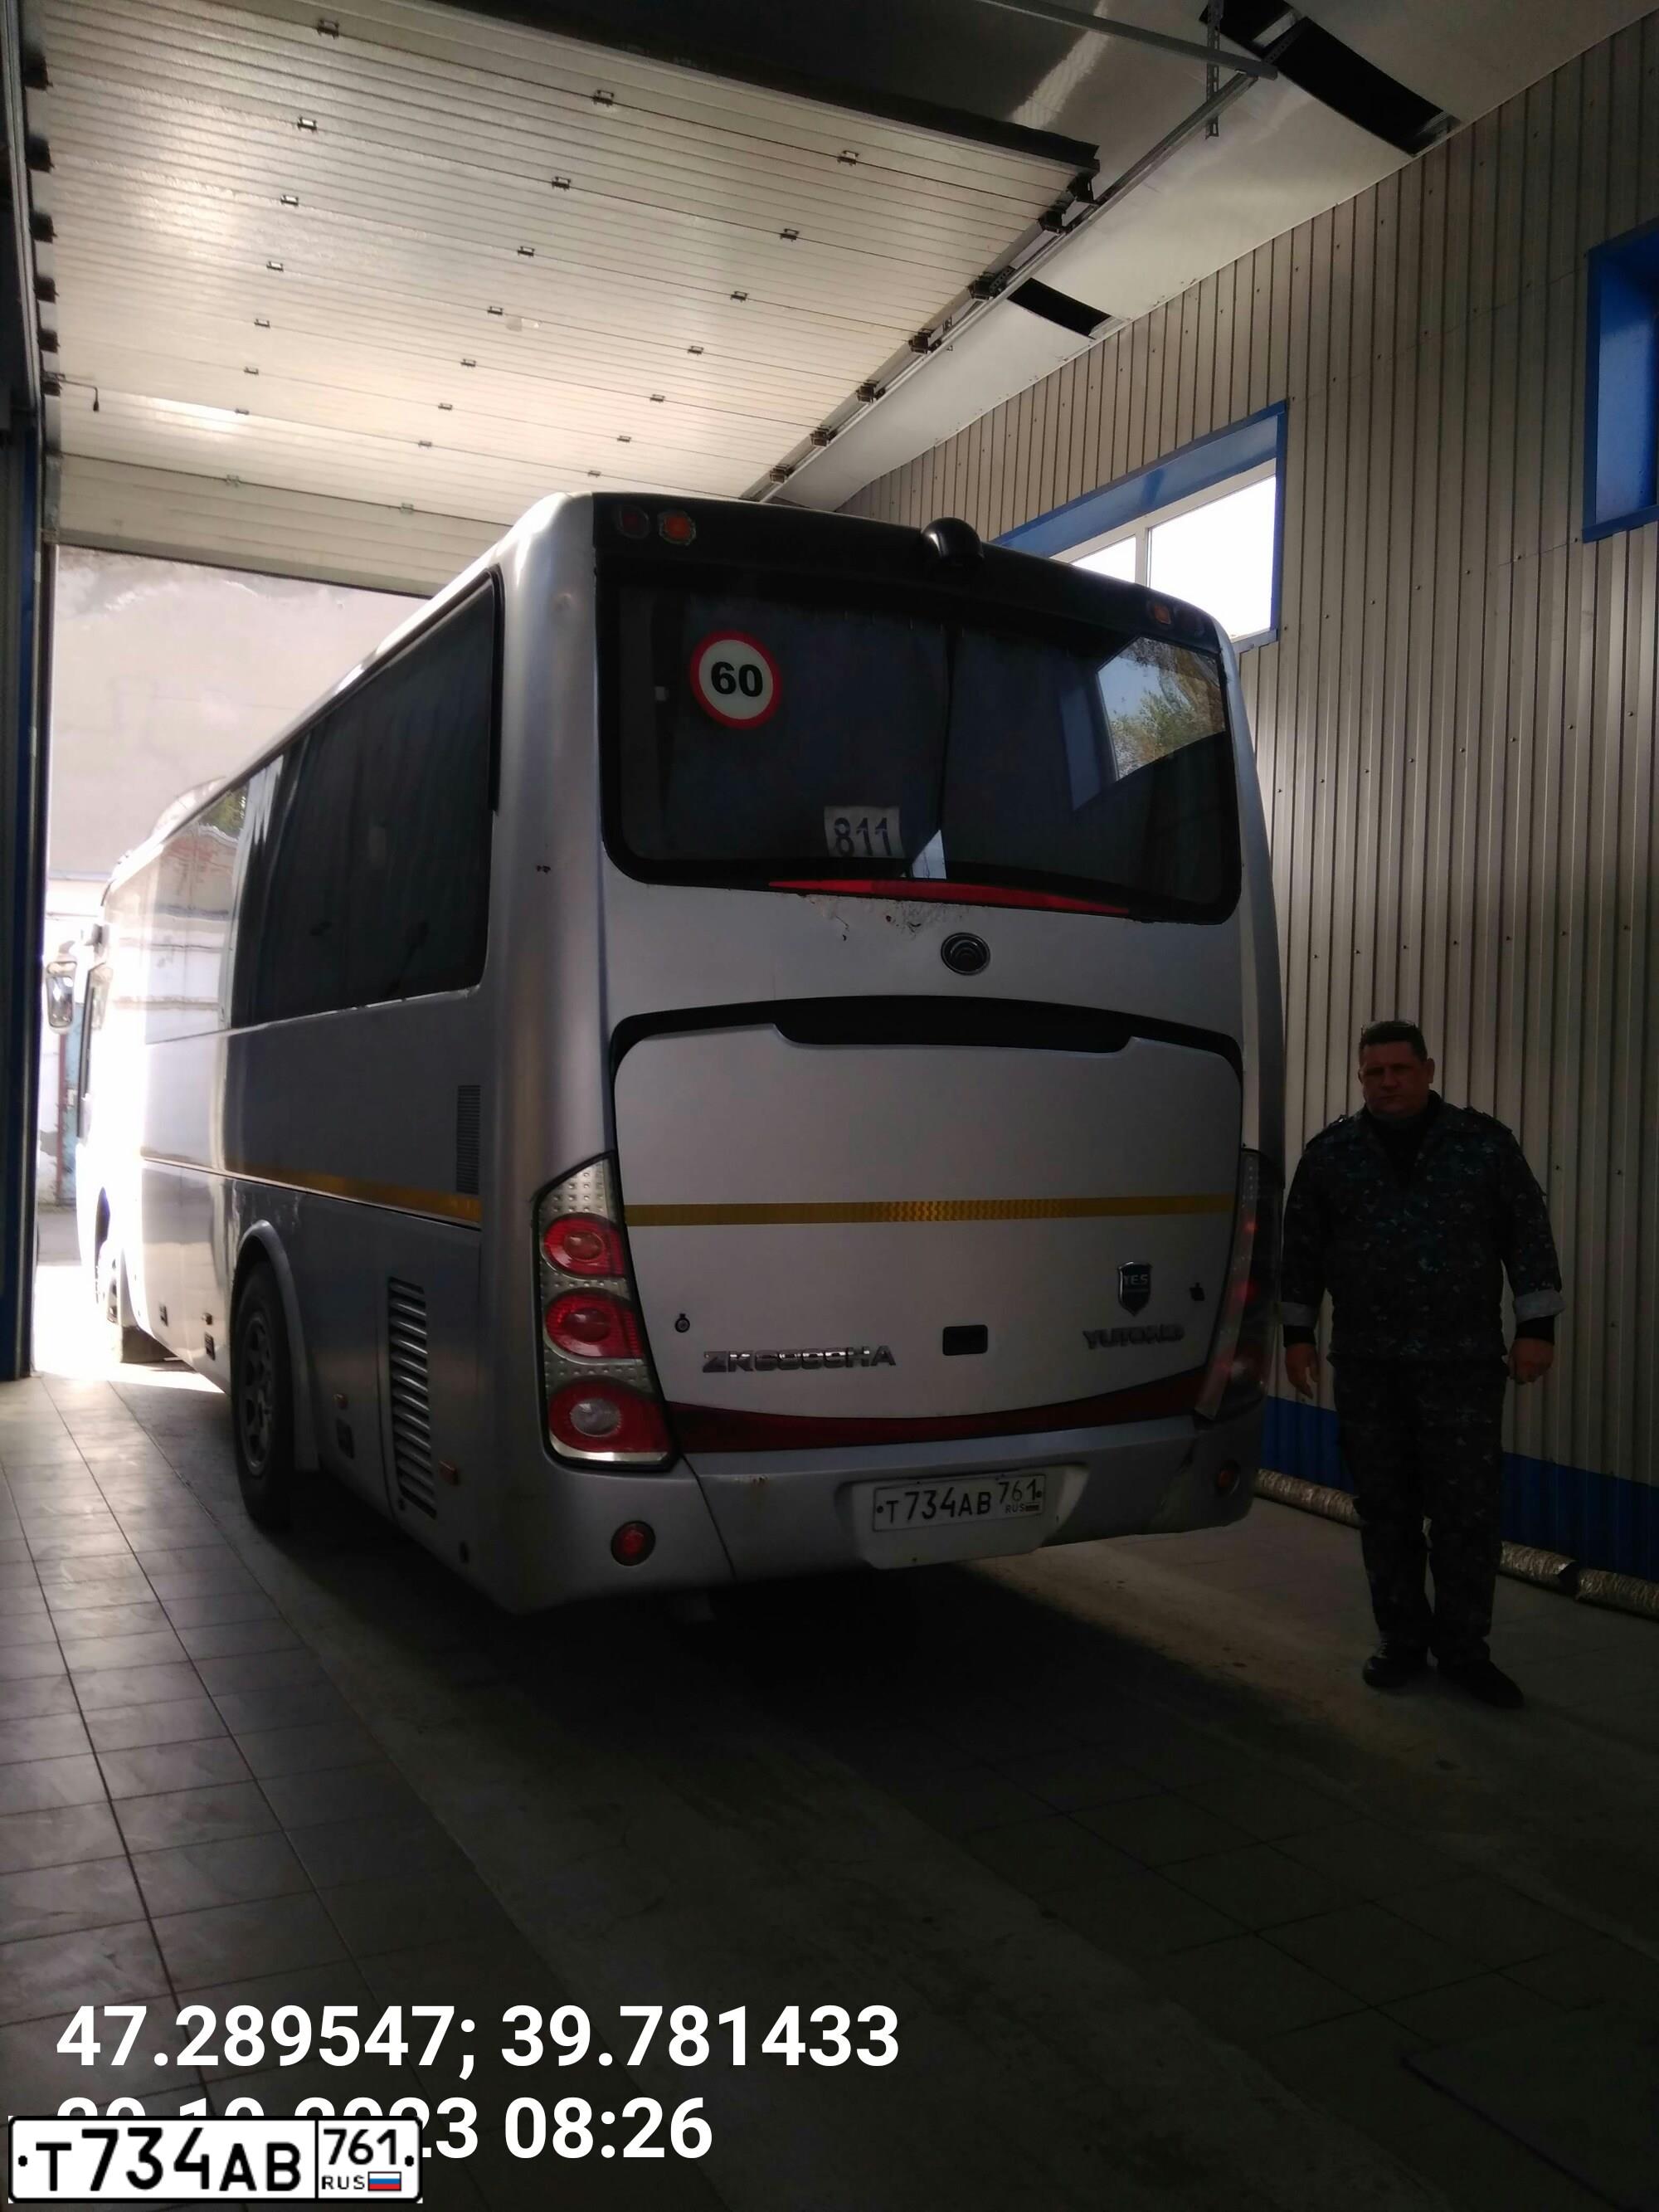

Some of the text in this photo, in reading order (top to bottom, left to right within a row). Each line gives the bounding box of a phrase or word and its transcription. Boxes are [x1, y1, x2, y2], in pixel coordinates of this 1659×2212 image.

[711, 662, 763, 698] 60
[834, 817, 893, 857] 811
[1005, 1503, 1024, 1513] RUS
